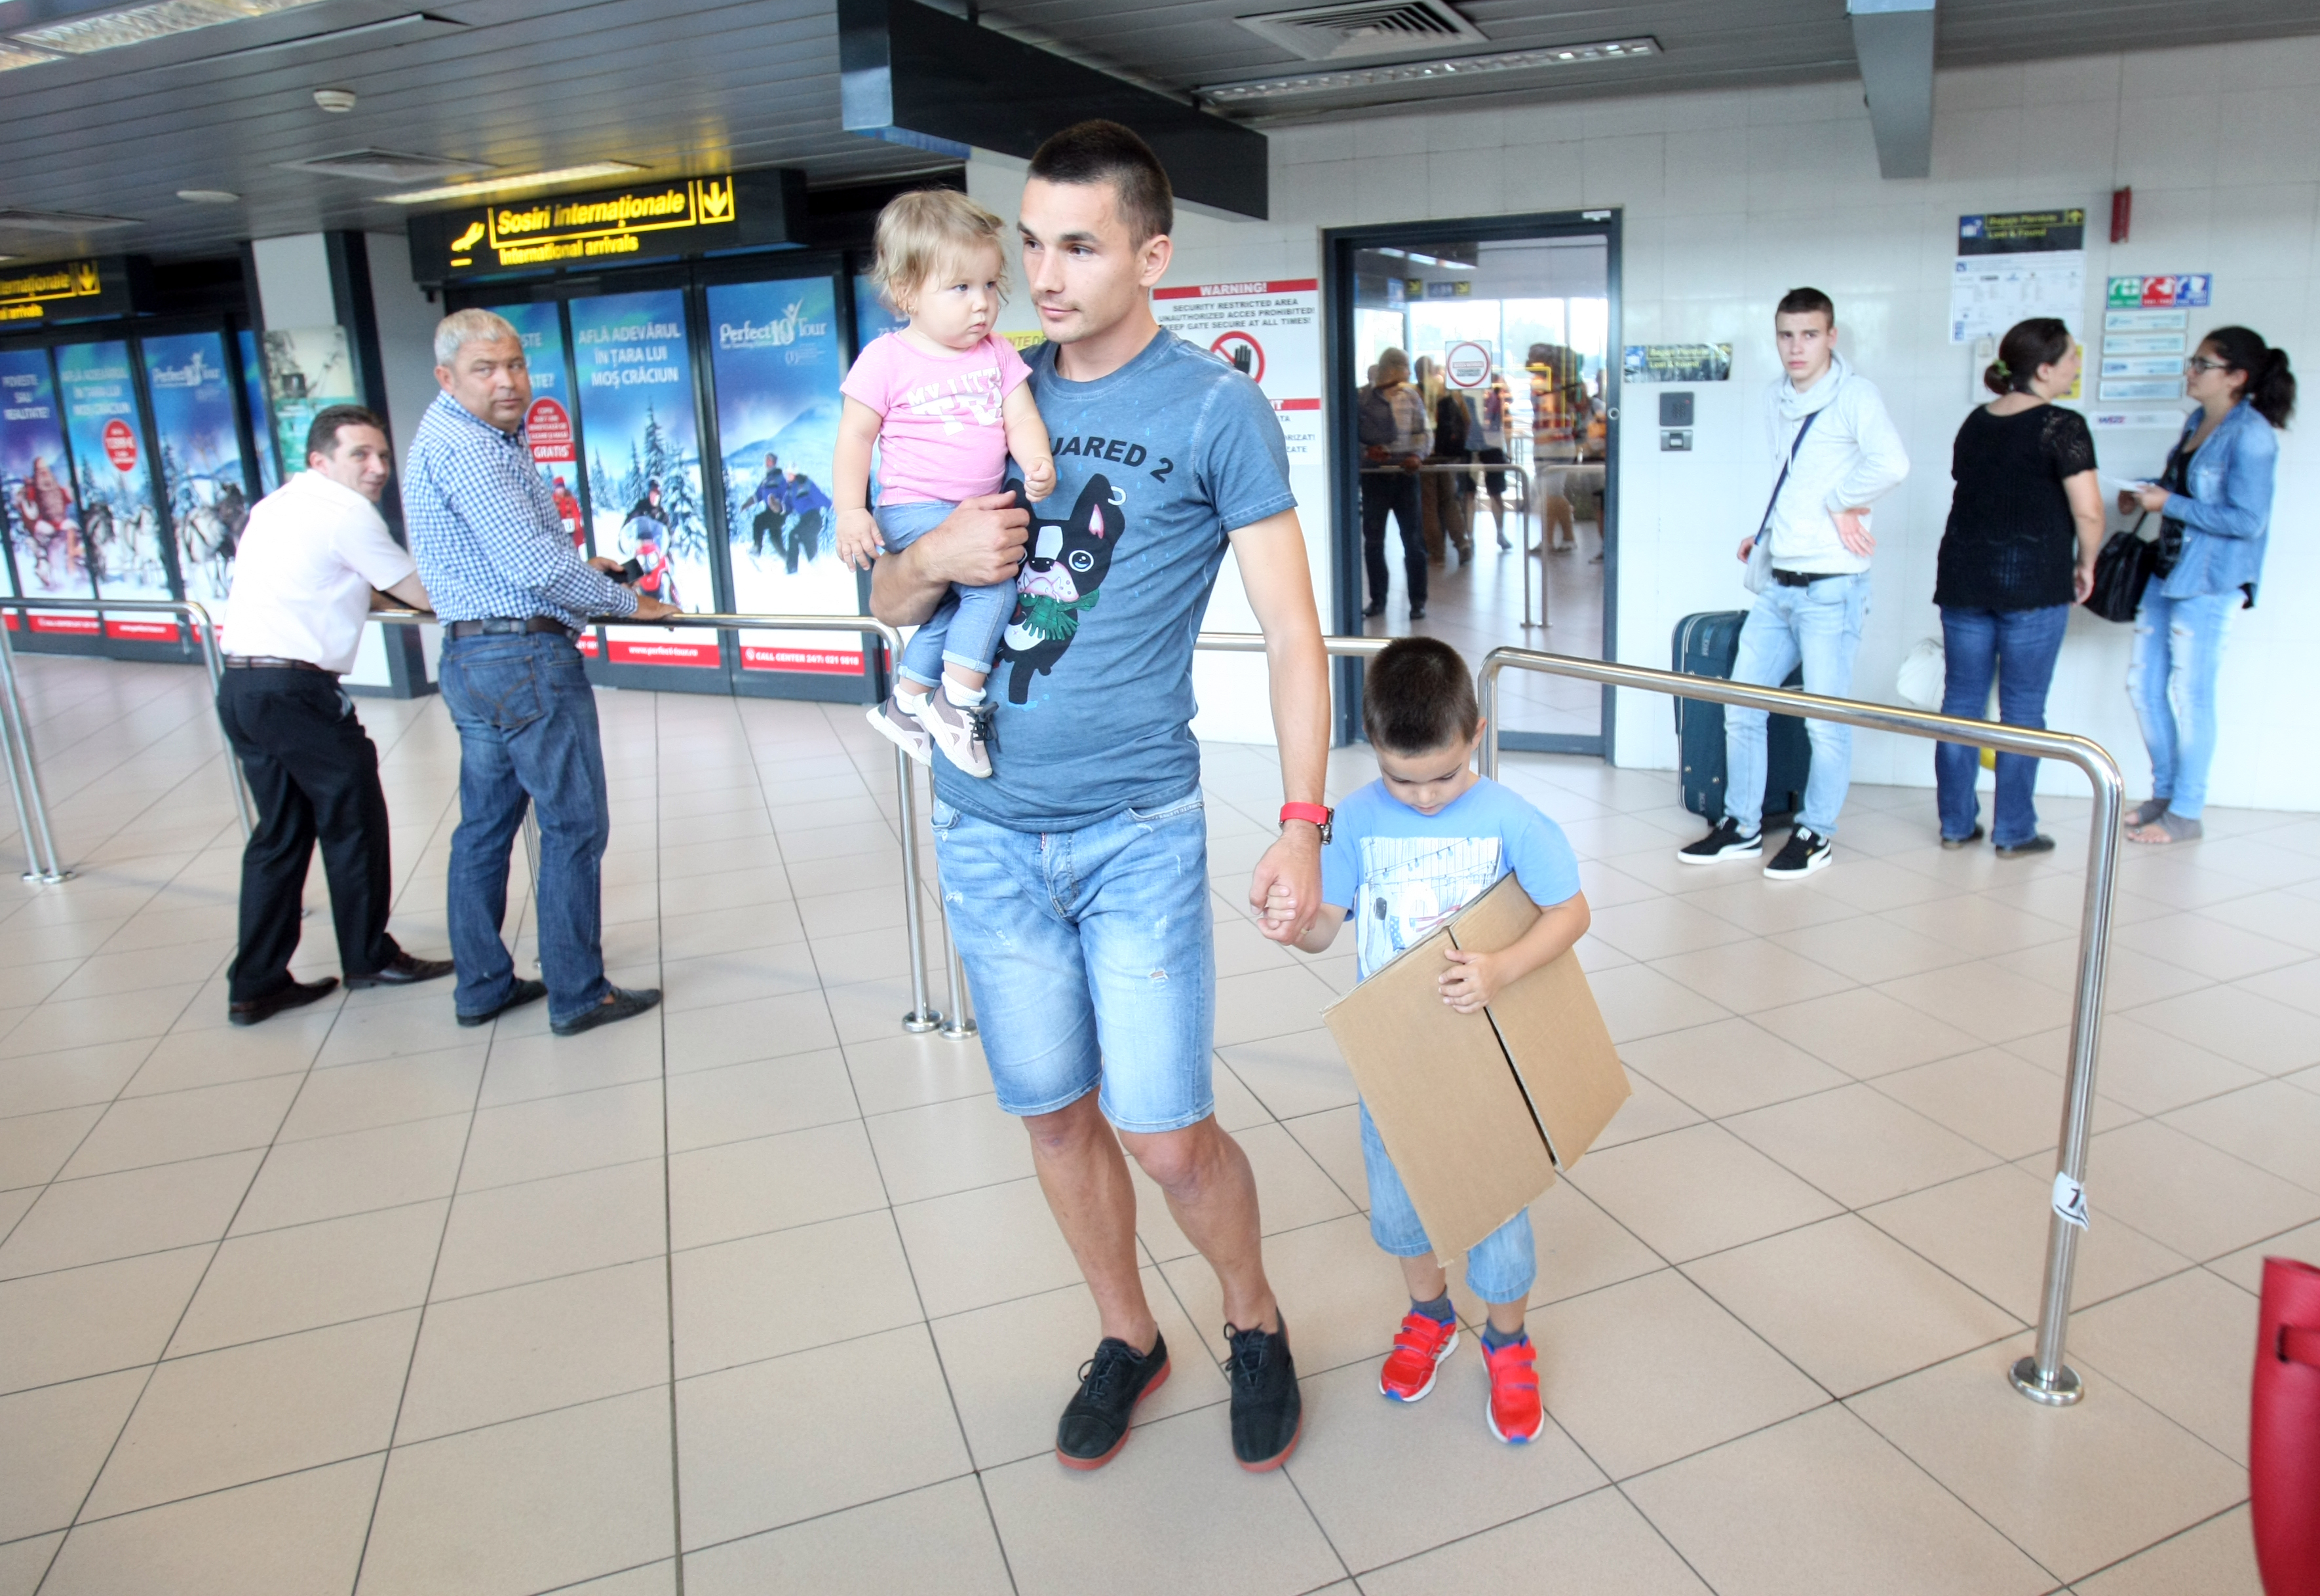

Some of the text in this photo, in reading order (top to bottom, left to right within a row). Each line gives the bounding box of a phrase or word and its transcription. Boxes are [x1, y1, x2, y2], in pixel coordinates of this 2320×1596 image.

[497, 205, 551, 235] Sosiri
[2019, 229, 2047, 238] Found
[499, 233, 639, 265] International arrivals
[1201, 282, 1267, 295] WARNING!
[1173, 303, 1215, 312] SECURITY
[1218, 300, 1272, 309] RESTRICTED
[1159, 307, 1315, 322] UNAUTHORIZED ACCES PROHIBITED!
[720, 320, 771, 343] Perfect
[797, 317, 827, 337] Tour
[1212, 320, 1246, 329] SECURE
[646, 345, 668, 361] LUI
[1150, 457, 1174, 484] 2
[755, 651, 775, 662] CALL
[775, 653, 805, 663] CENTER
[824, 655, 840, 664] 021
